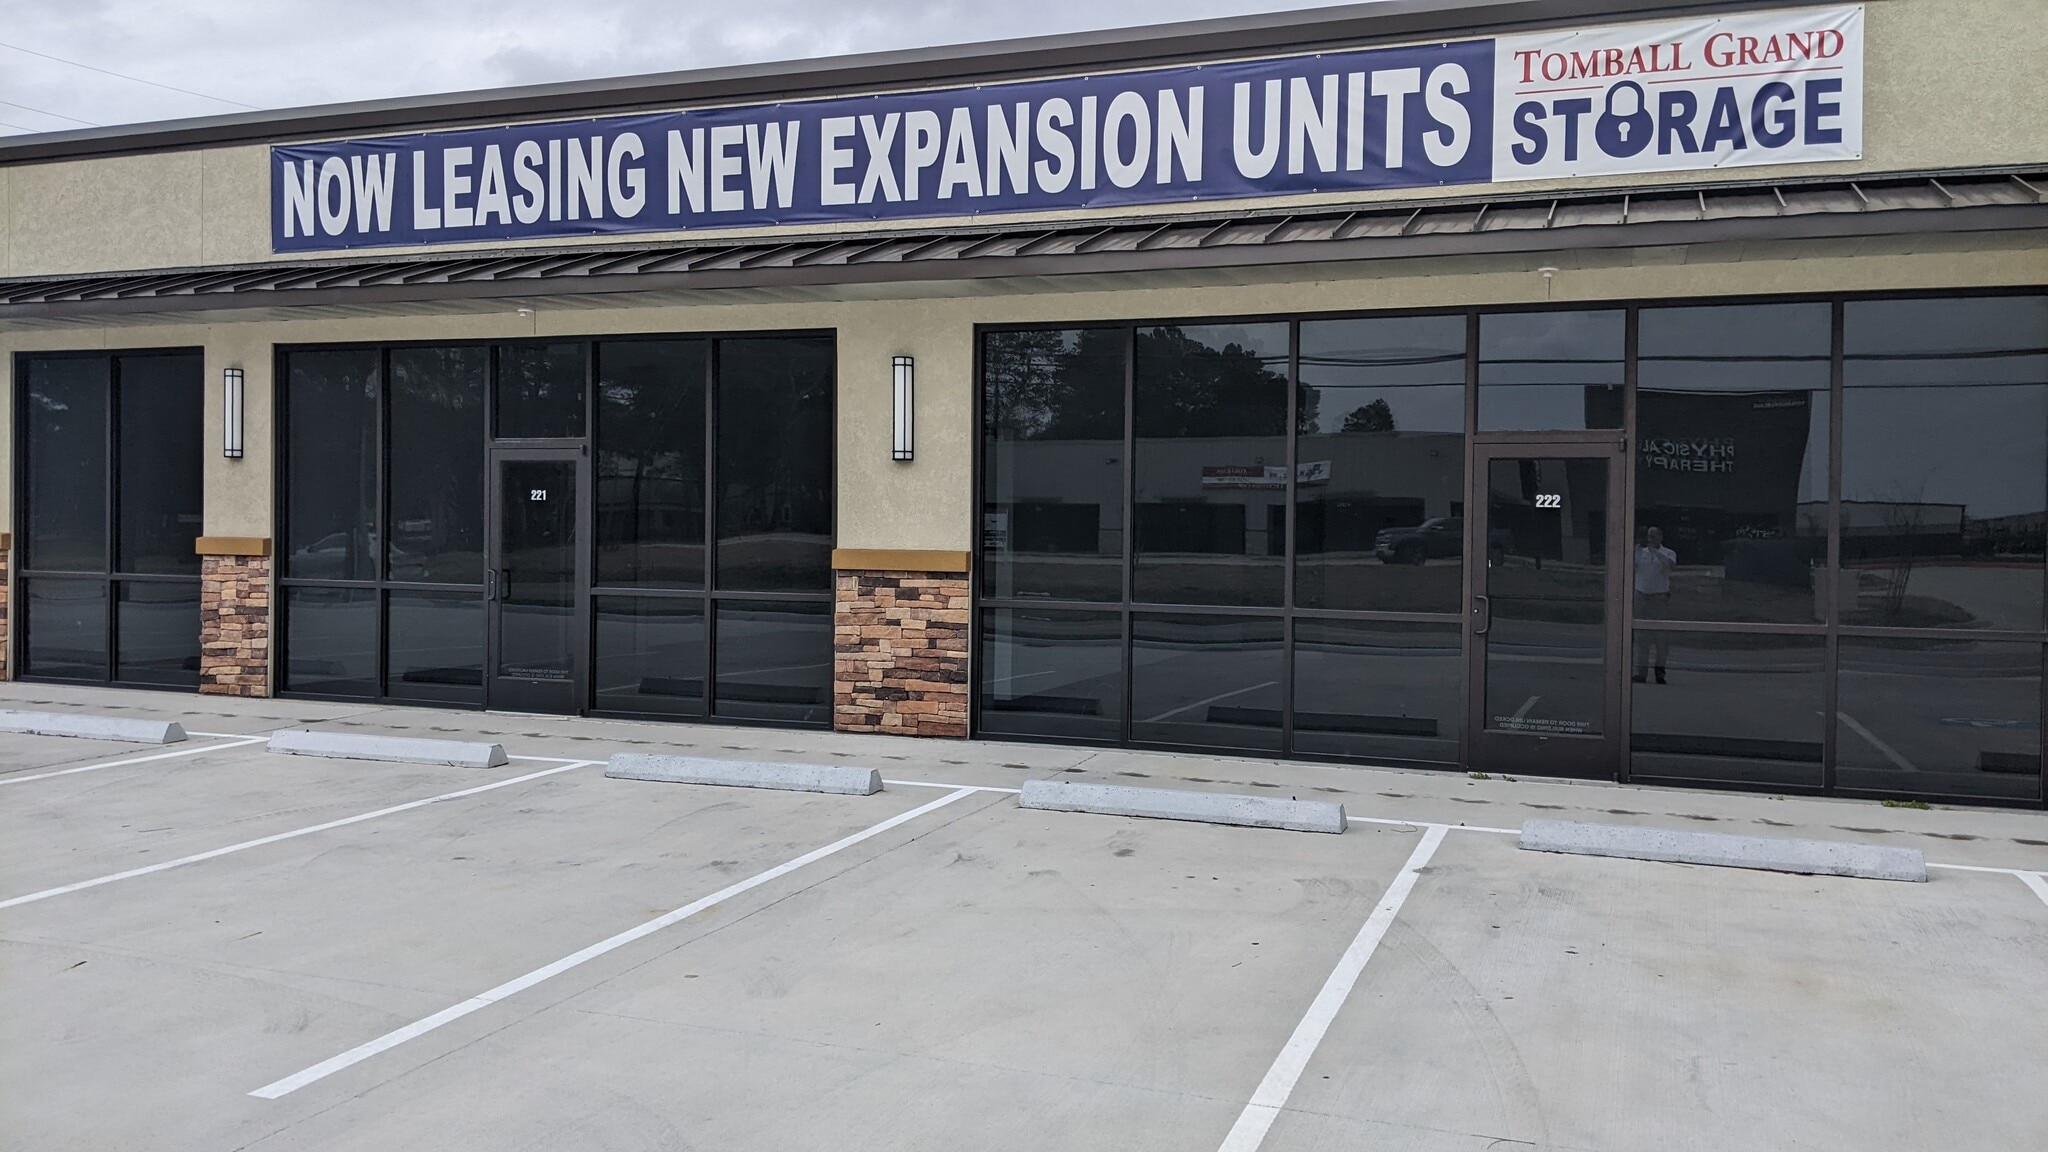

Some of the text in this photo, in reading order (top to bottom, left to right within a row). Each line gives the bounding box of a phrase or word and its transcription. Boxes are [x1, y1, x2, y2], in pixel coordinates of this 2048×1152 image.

[1513, 29, 1845, 84] TOMBALL GRAND
[283, 62, 1472, 239] NOW LEASING NEW EXPANSION UNITS
[531, 489, 547, 501] 221
[1535, 494, 1561, 508] 222
